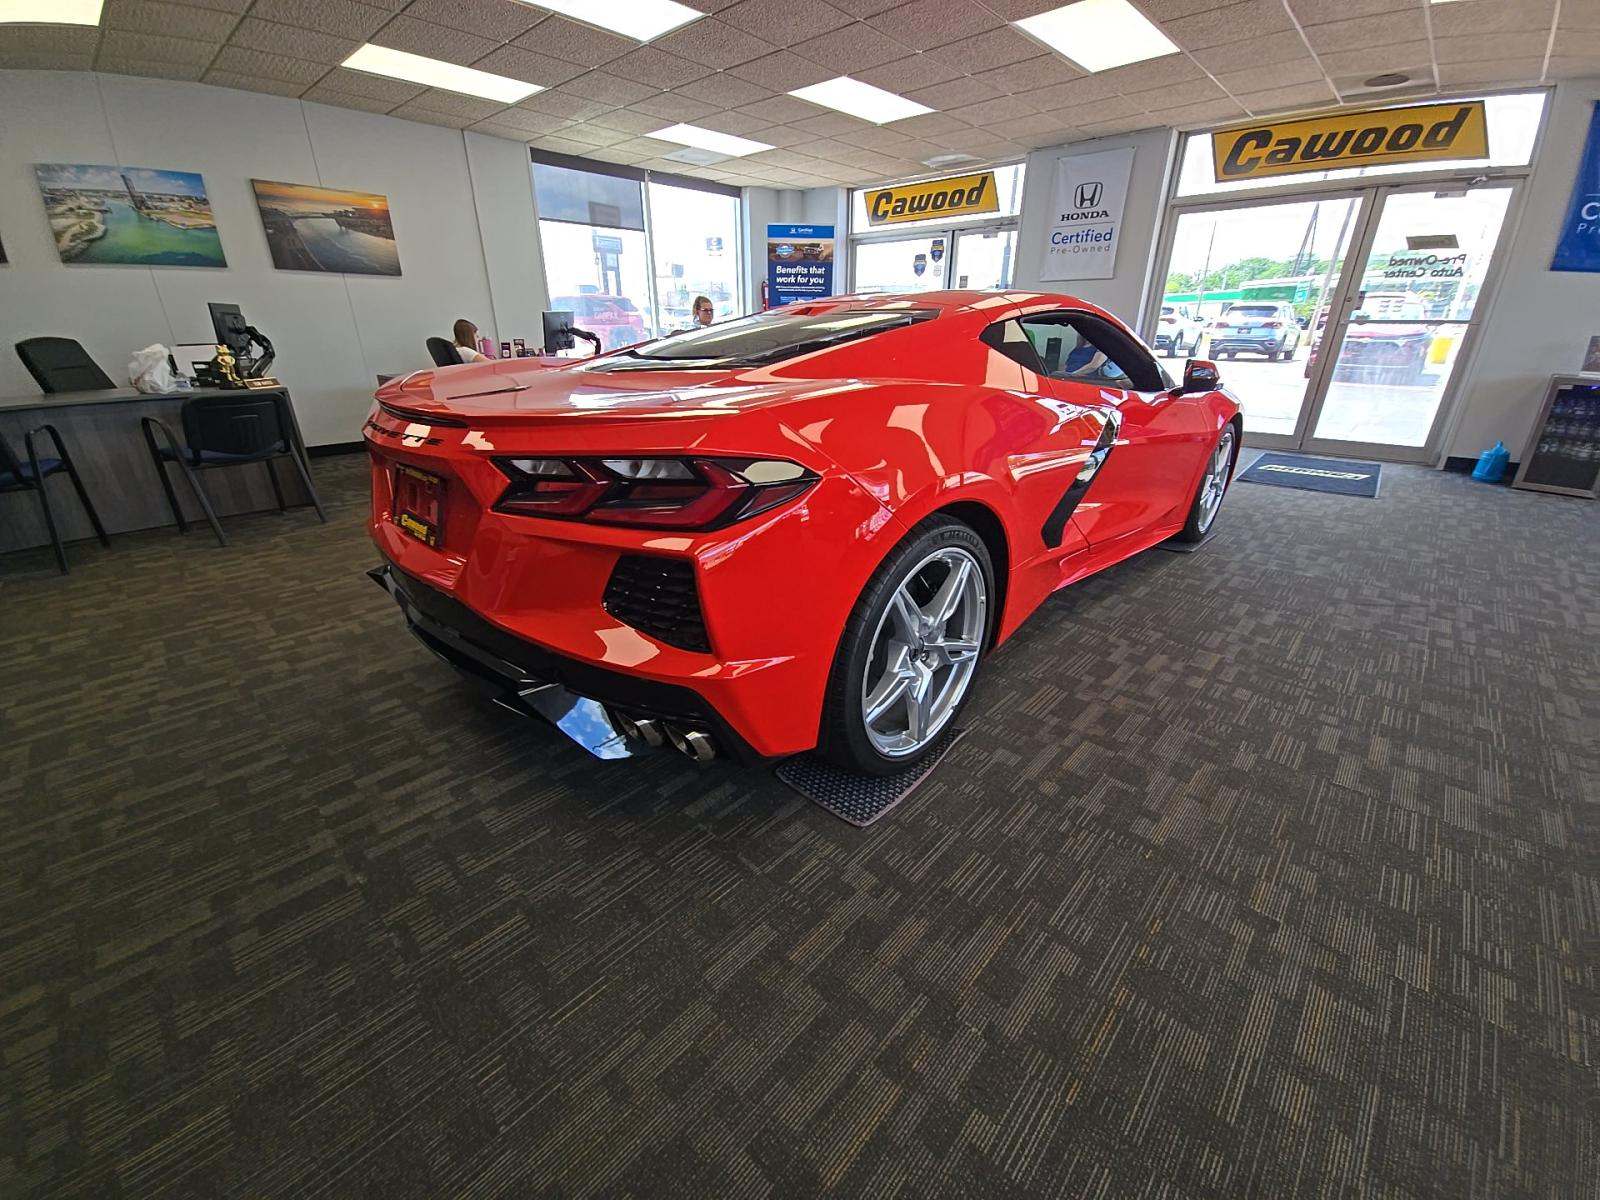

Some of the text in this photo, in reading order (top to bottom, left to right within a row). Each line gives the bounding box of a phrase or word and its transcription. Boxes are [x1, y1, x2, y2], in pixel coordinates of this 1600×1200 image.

[1222, 107, 1472, 176] Cawood
[871, 176, 989, 222] Cawood
[1060, 210, 1109, 221] HONDA
[1581, 202, 1600, 220] C
[1051, 227, 1113, 245] Certified
[1050, 244, 1111, 254] Pre-Owned
[776, 266, 825, 274] Benefits that
[776, 275, 795, 283] work
[797, 275, 808, 283] for
